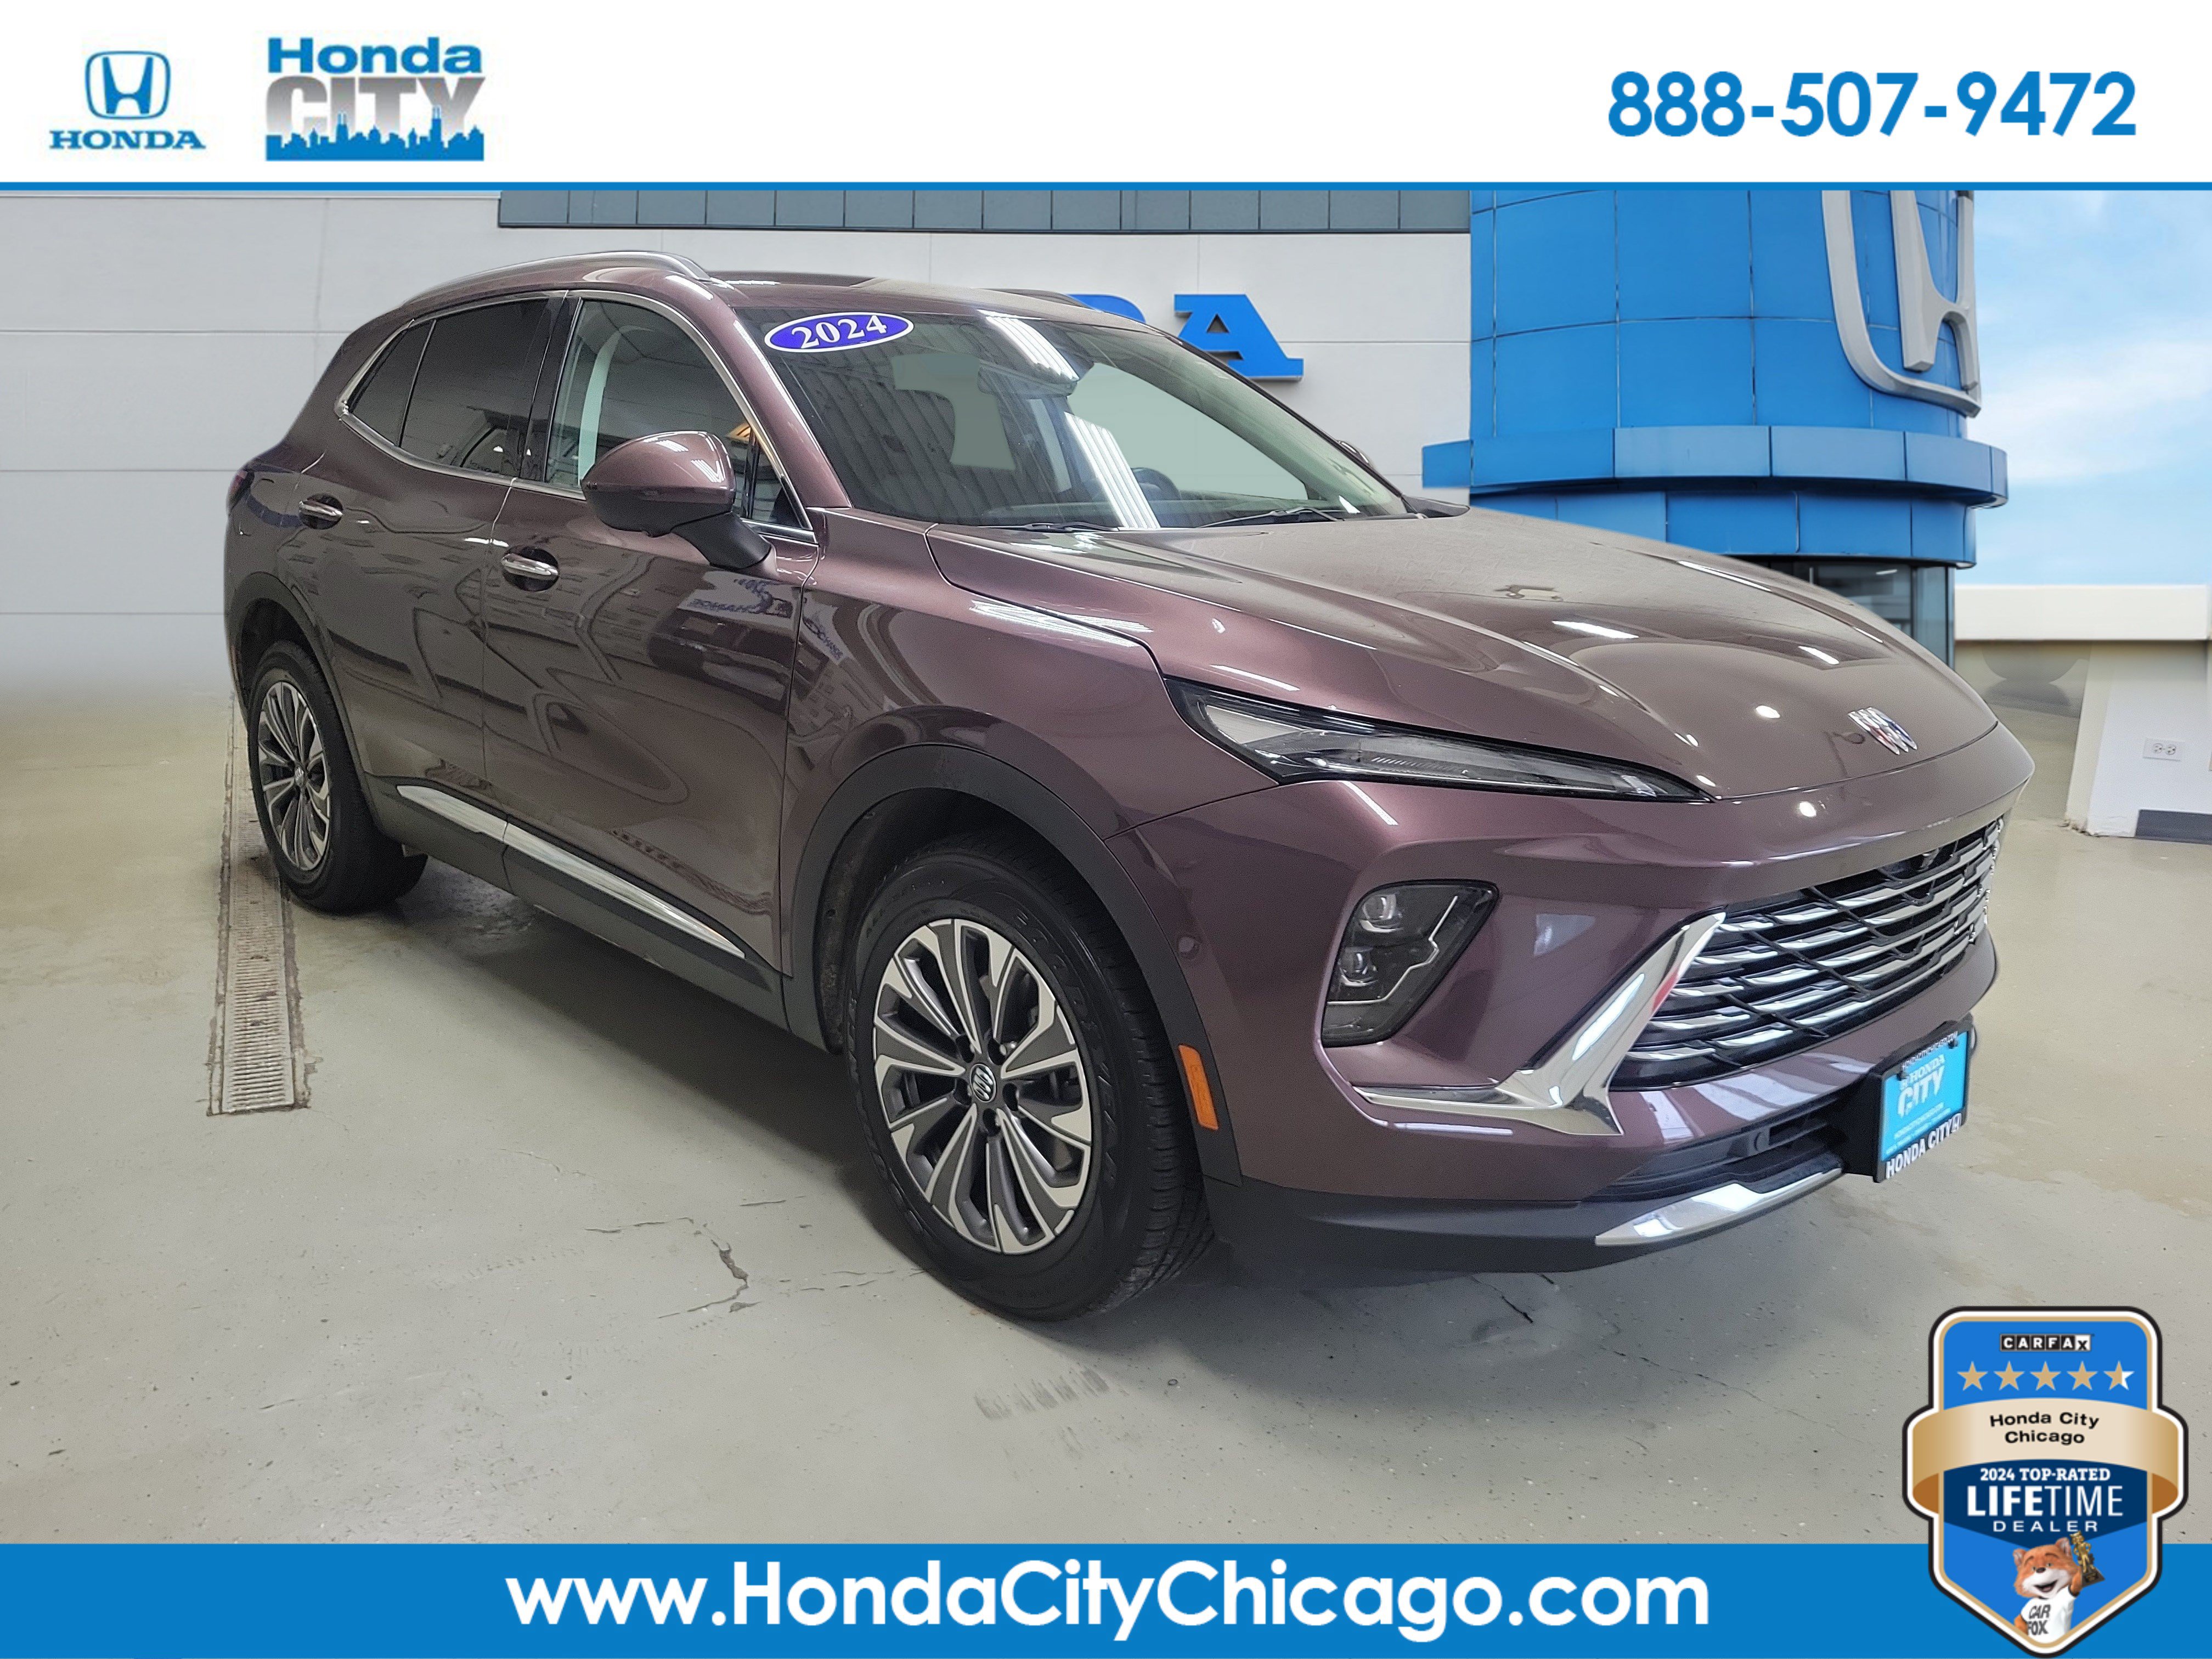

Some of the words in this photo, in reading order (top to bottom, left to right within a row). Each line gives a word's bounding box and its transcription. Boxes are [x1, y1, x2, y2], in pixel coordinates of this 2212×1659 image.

[791, 315, 887, 349] 2024
[1897, 1065, 1945, 1118] CITY
[1886, 1138, 1926, 1179] HONDA
[1928, 1119, 1953, 1148] CITY
